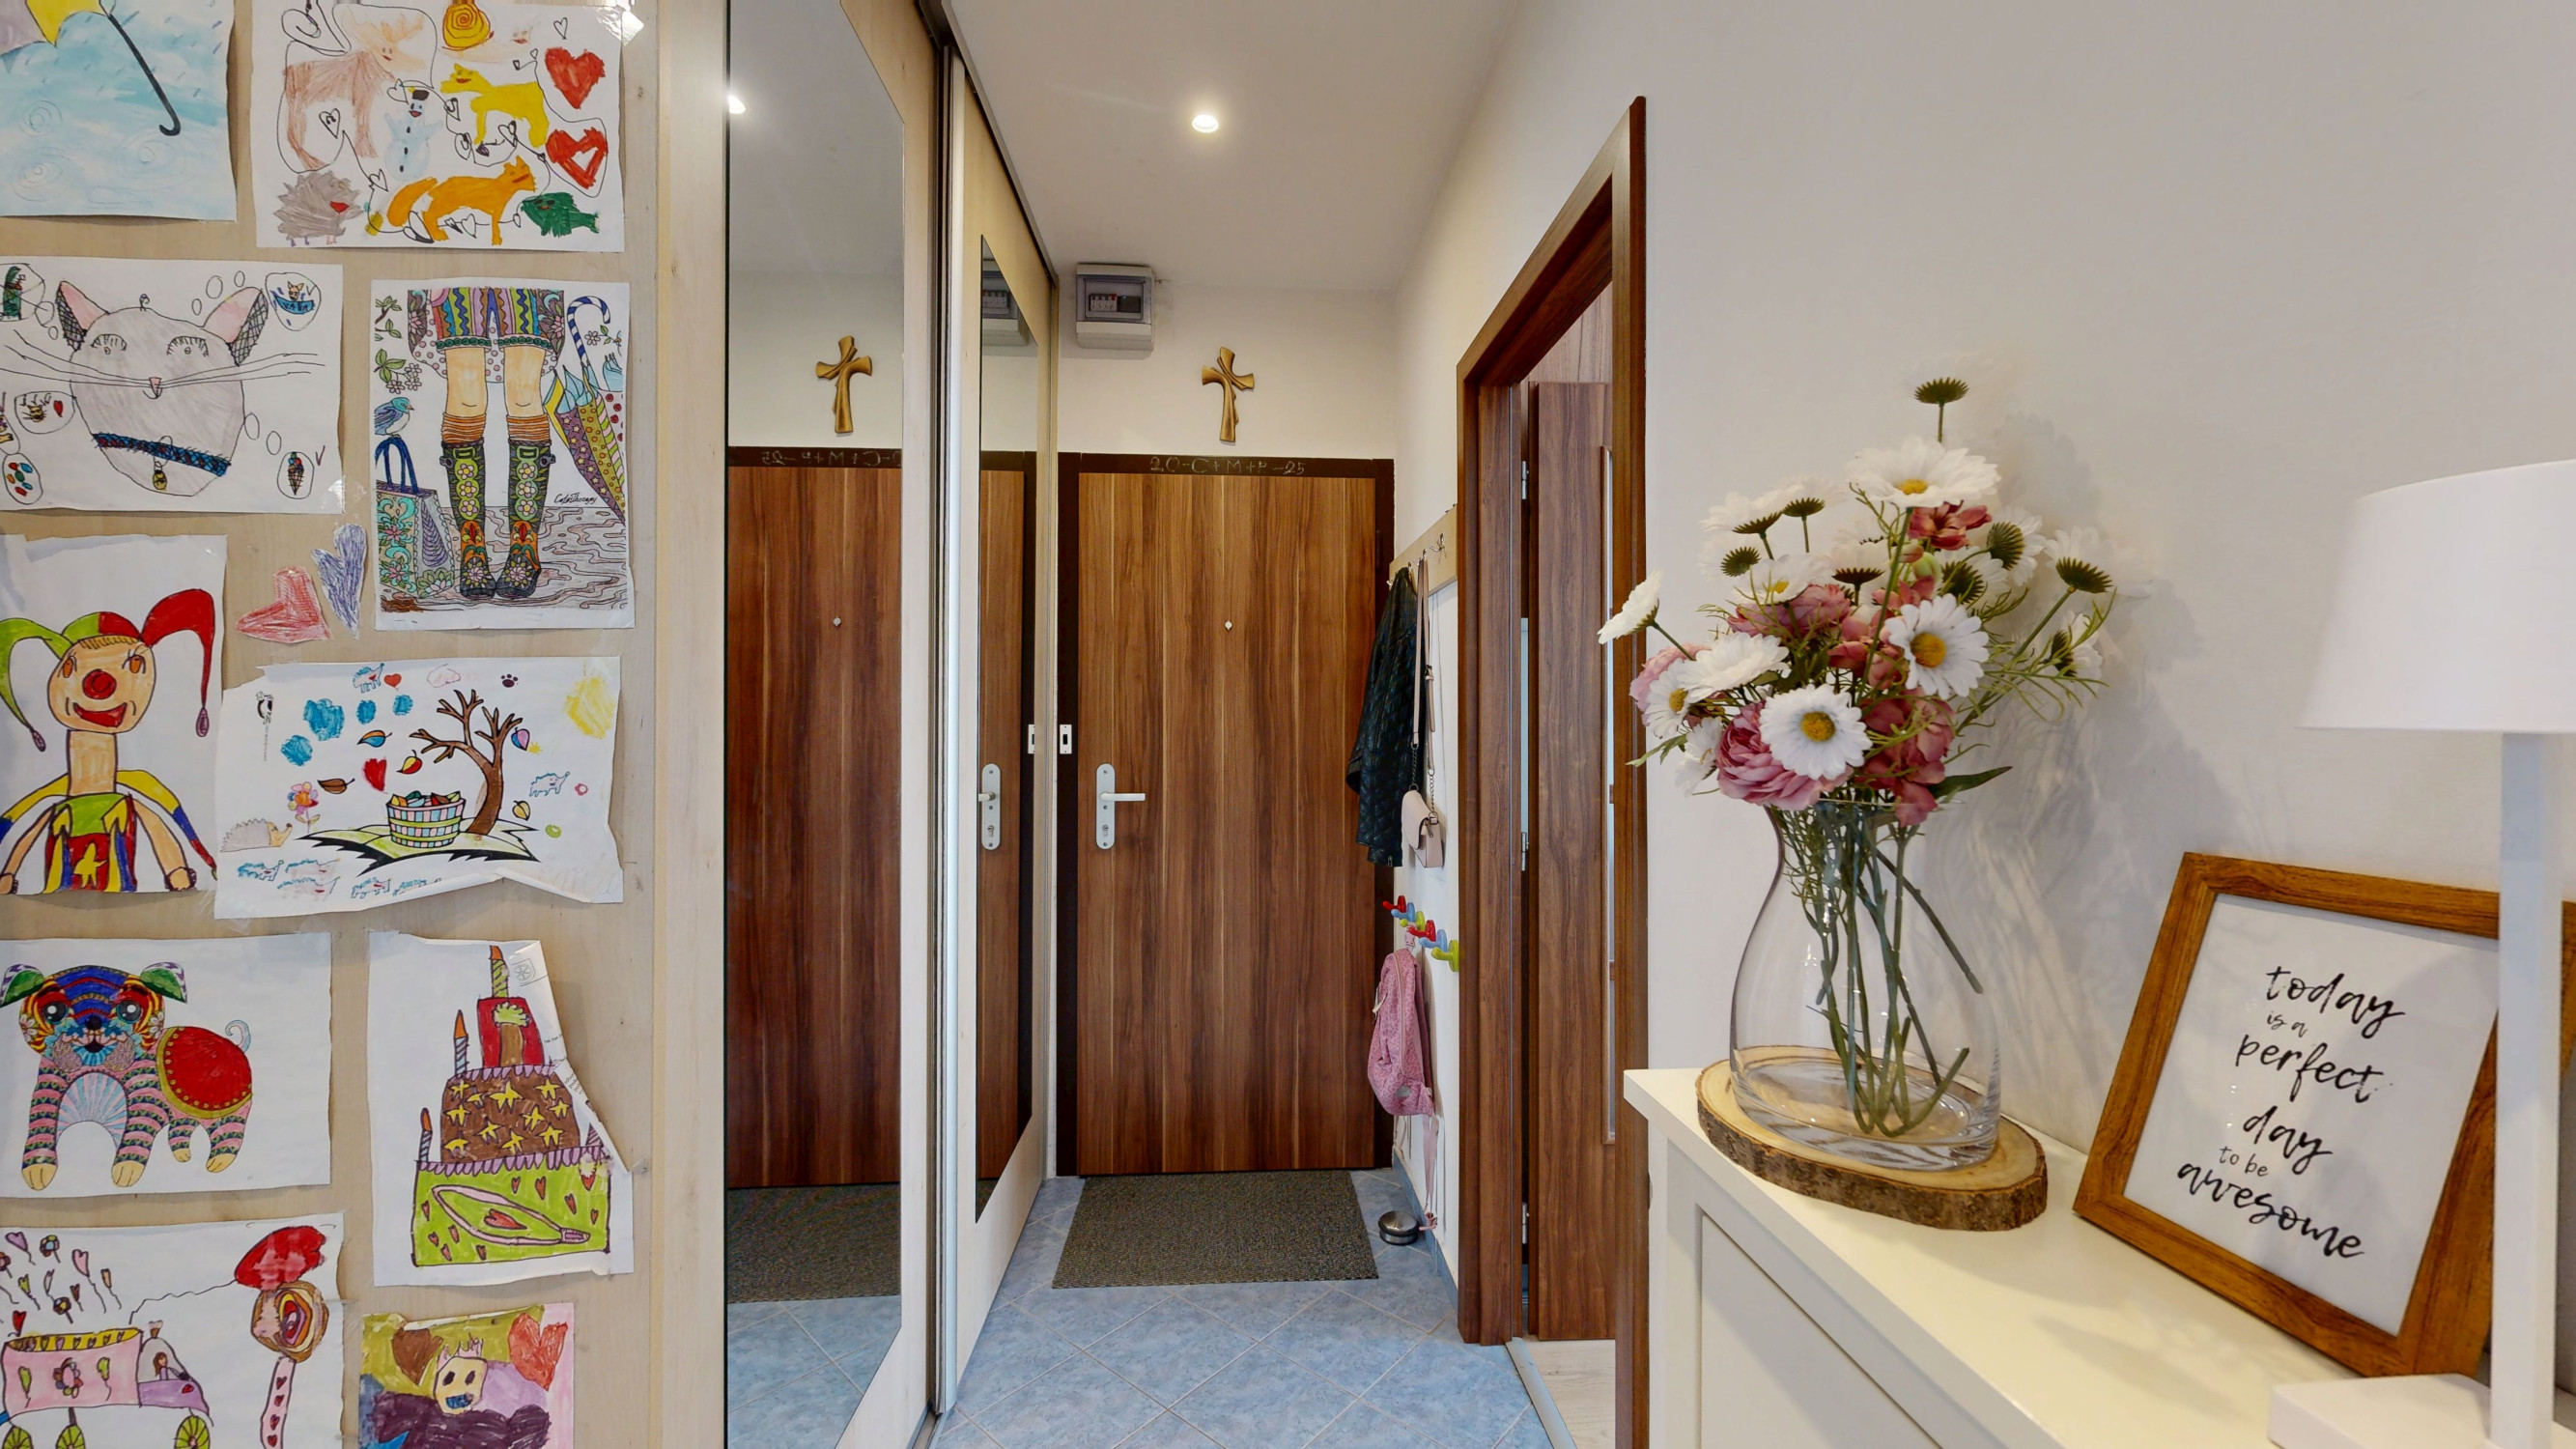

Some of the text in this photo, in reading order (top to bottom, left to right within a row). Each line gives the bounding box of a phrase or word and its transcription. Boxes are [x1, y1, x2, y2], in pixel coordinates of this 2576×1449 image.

[2266, 966, 2405, 1038] today
[2267, 1010, 2307, 1037] is a
[2235, 1034, 2383, 1103] perfect
[2219, 1146, 2268, 1177] to be
[2243, 1105, 2333, 1175] day
[2177, 1163, 2364, 1258] awesome
